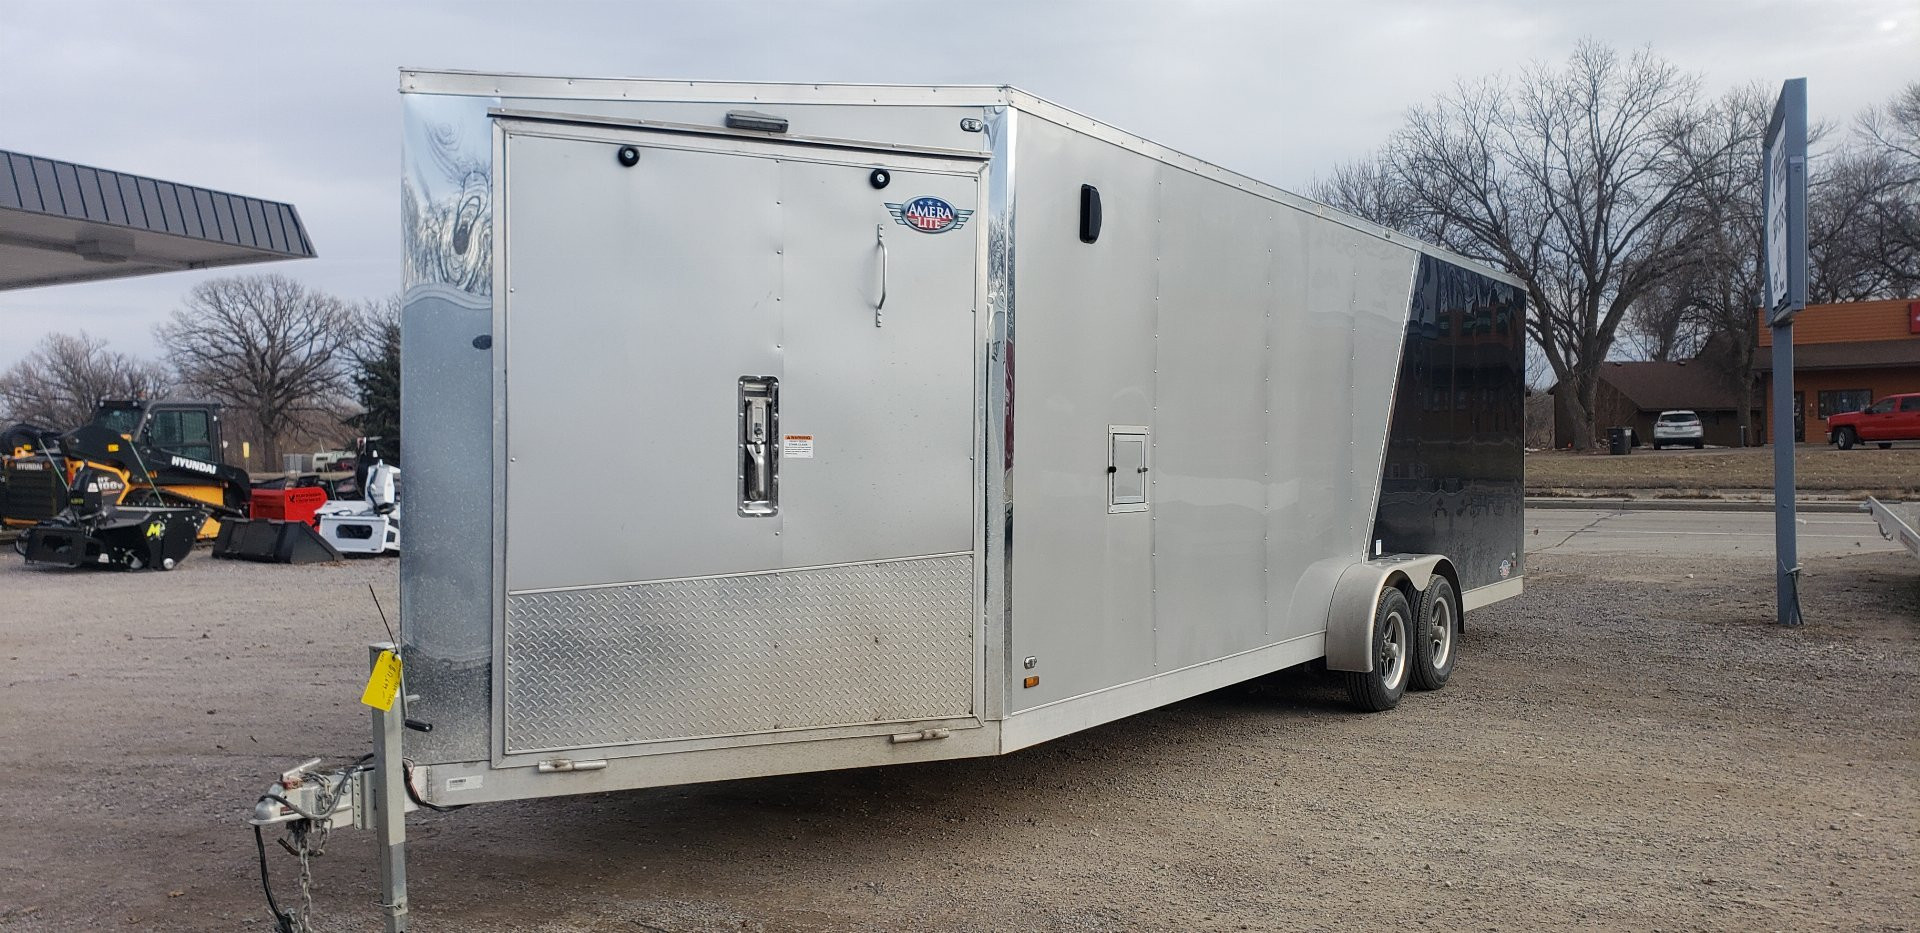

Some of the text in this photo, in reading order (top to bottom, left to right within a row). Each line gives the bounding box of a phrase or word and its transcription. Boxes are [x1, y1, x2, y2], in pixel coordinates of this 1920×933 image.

[907, 203, 953, 219] AMERA
[917, 216, 941, 229] LITE
[16, 462, 43, 471] HYUNDAI
[172, 455, 217, 475] HYUNDAI
